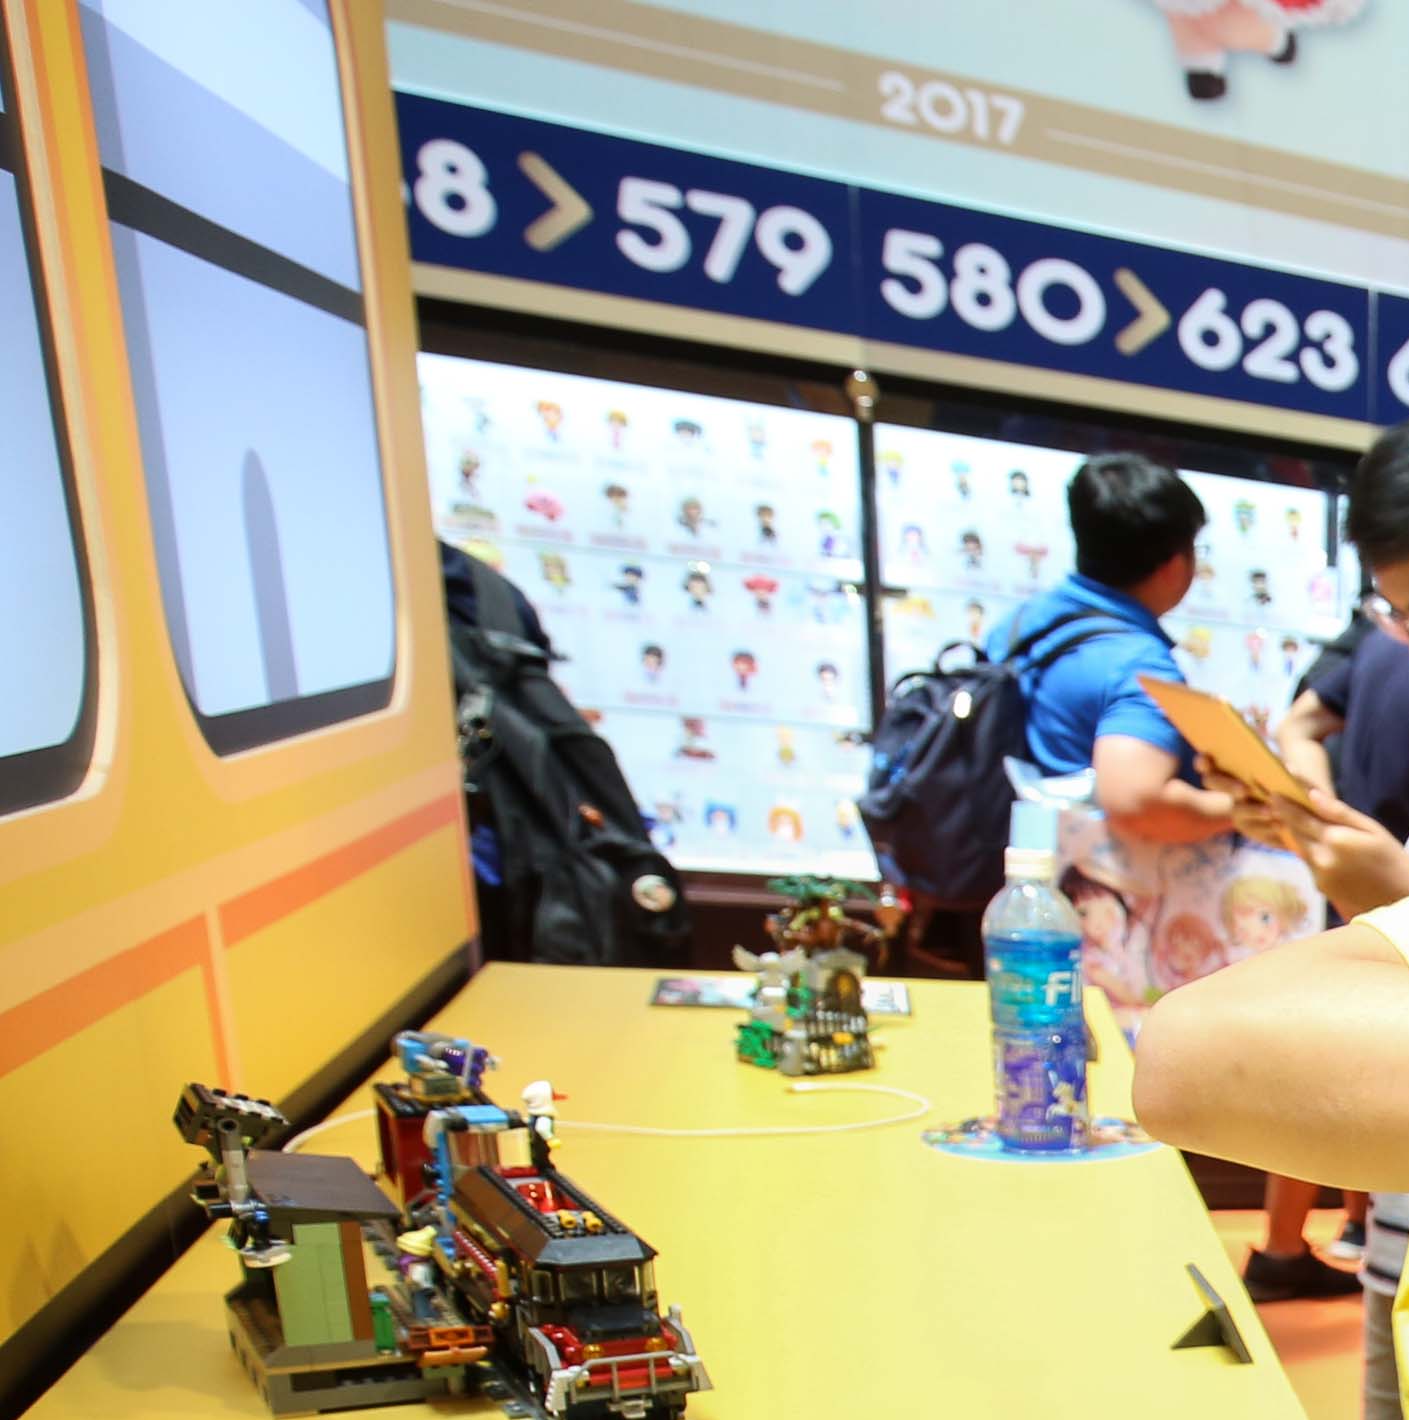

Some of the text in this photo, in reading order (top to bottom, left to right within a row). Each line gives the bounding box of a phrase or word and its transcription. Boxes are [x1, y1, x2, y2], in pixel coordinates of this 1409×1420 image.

[877, 70, 1026, 145] 2017
[404, 138, 832, 296] 8 579
[880, 228, 1360, 392] 580 623
